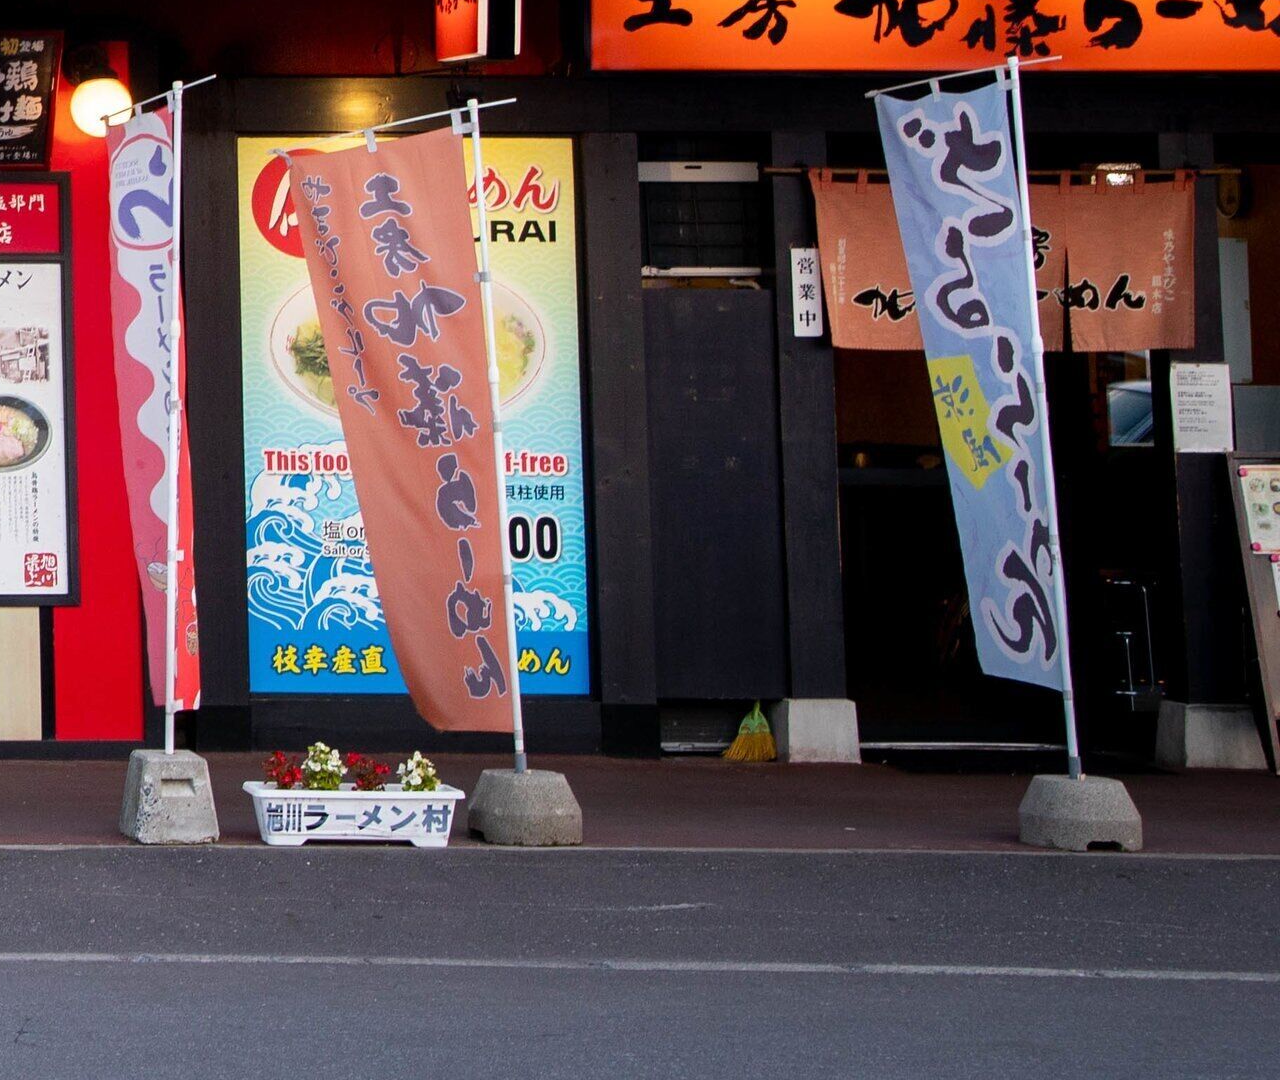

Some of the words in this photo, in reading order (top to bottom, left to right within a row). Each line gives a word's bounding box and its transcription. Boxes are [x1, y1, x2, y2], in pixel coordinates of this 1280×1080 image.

[797, 257, 816, 327] 営業中
[264, 451, 308, 473] This
[315, 451, 353, 473] foo
[323, 522, 342, 539] 塩
[323, 544, 346, 556] Salt
[273, 646, 386, 674] 枝幸産直
[266, 802, 451, 833] 旭川ラーメン村
